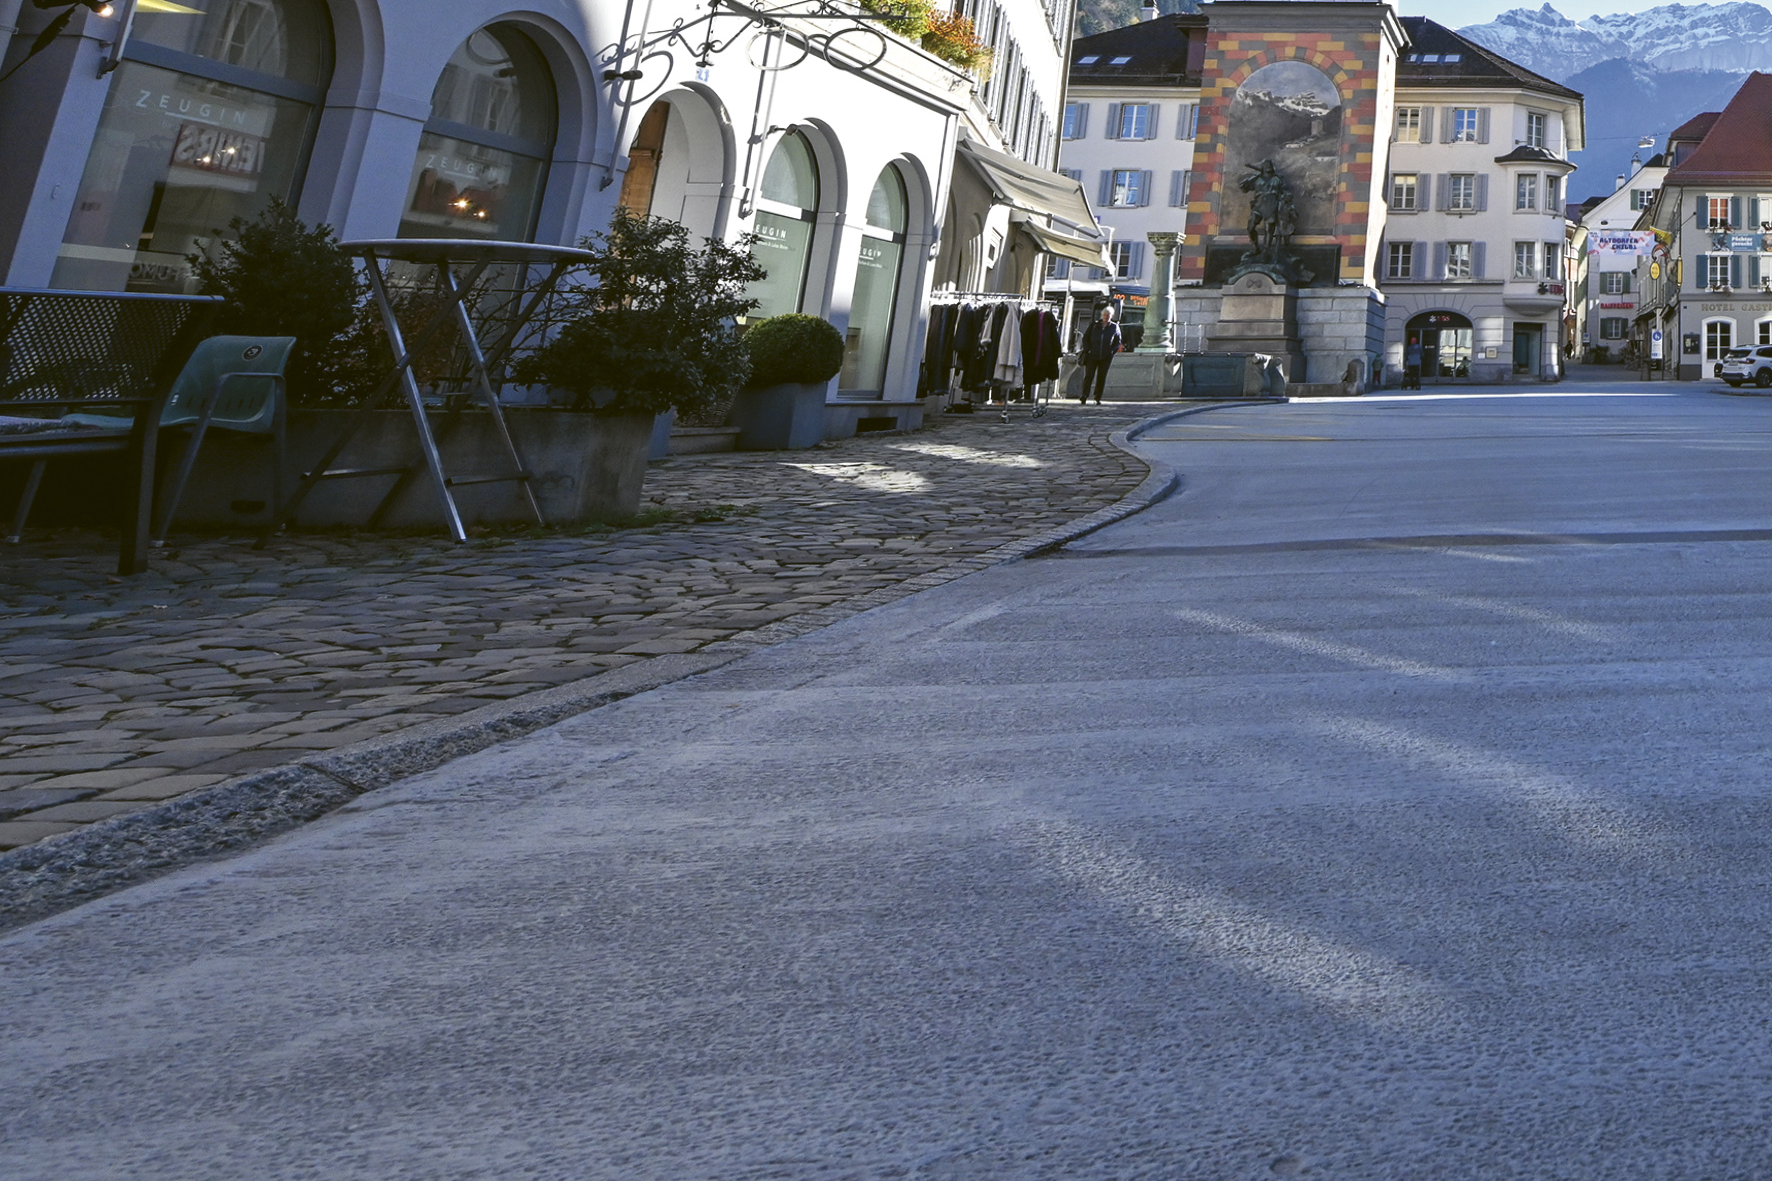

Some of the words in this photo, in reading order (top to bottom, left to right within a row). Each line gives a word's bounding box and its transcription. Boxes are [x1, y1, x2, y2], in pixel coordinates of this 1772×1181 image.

[135, 89, 246, 125] ZEUGIN
[425, 154, 498, 178] ZEUGIN
[755, 223, 787, 239] EUGIN
[1701, 303, 1735, 311] HOTEL
